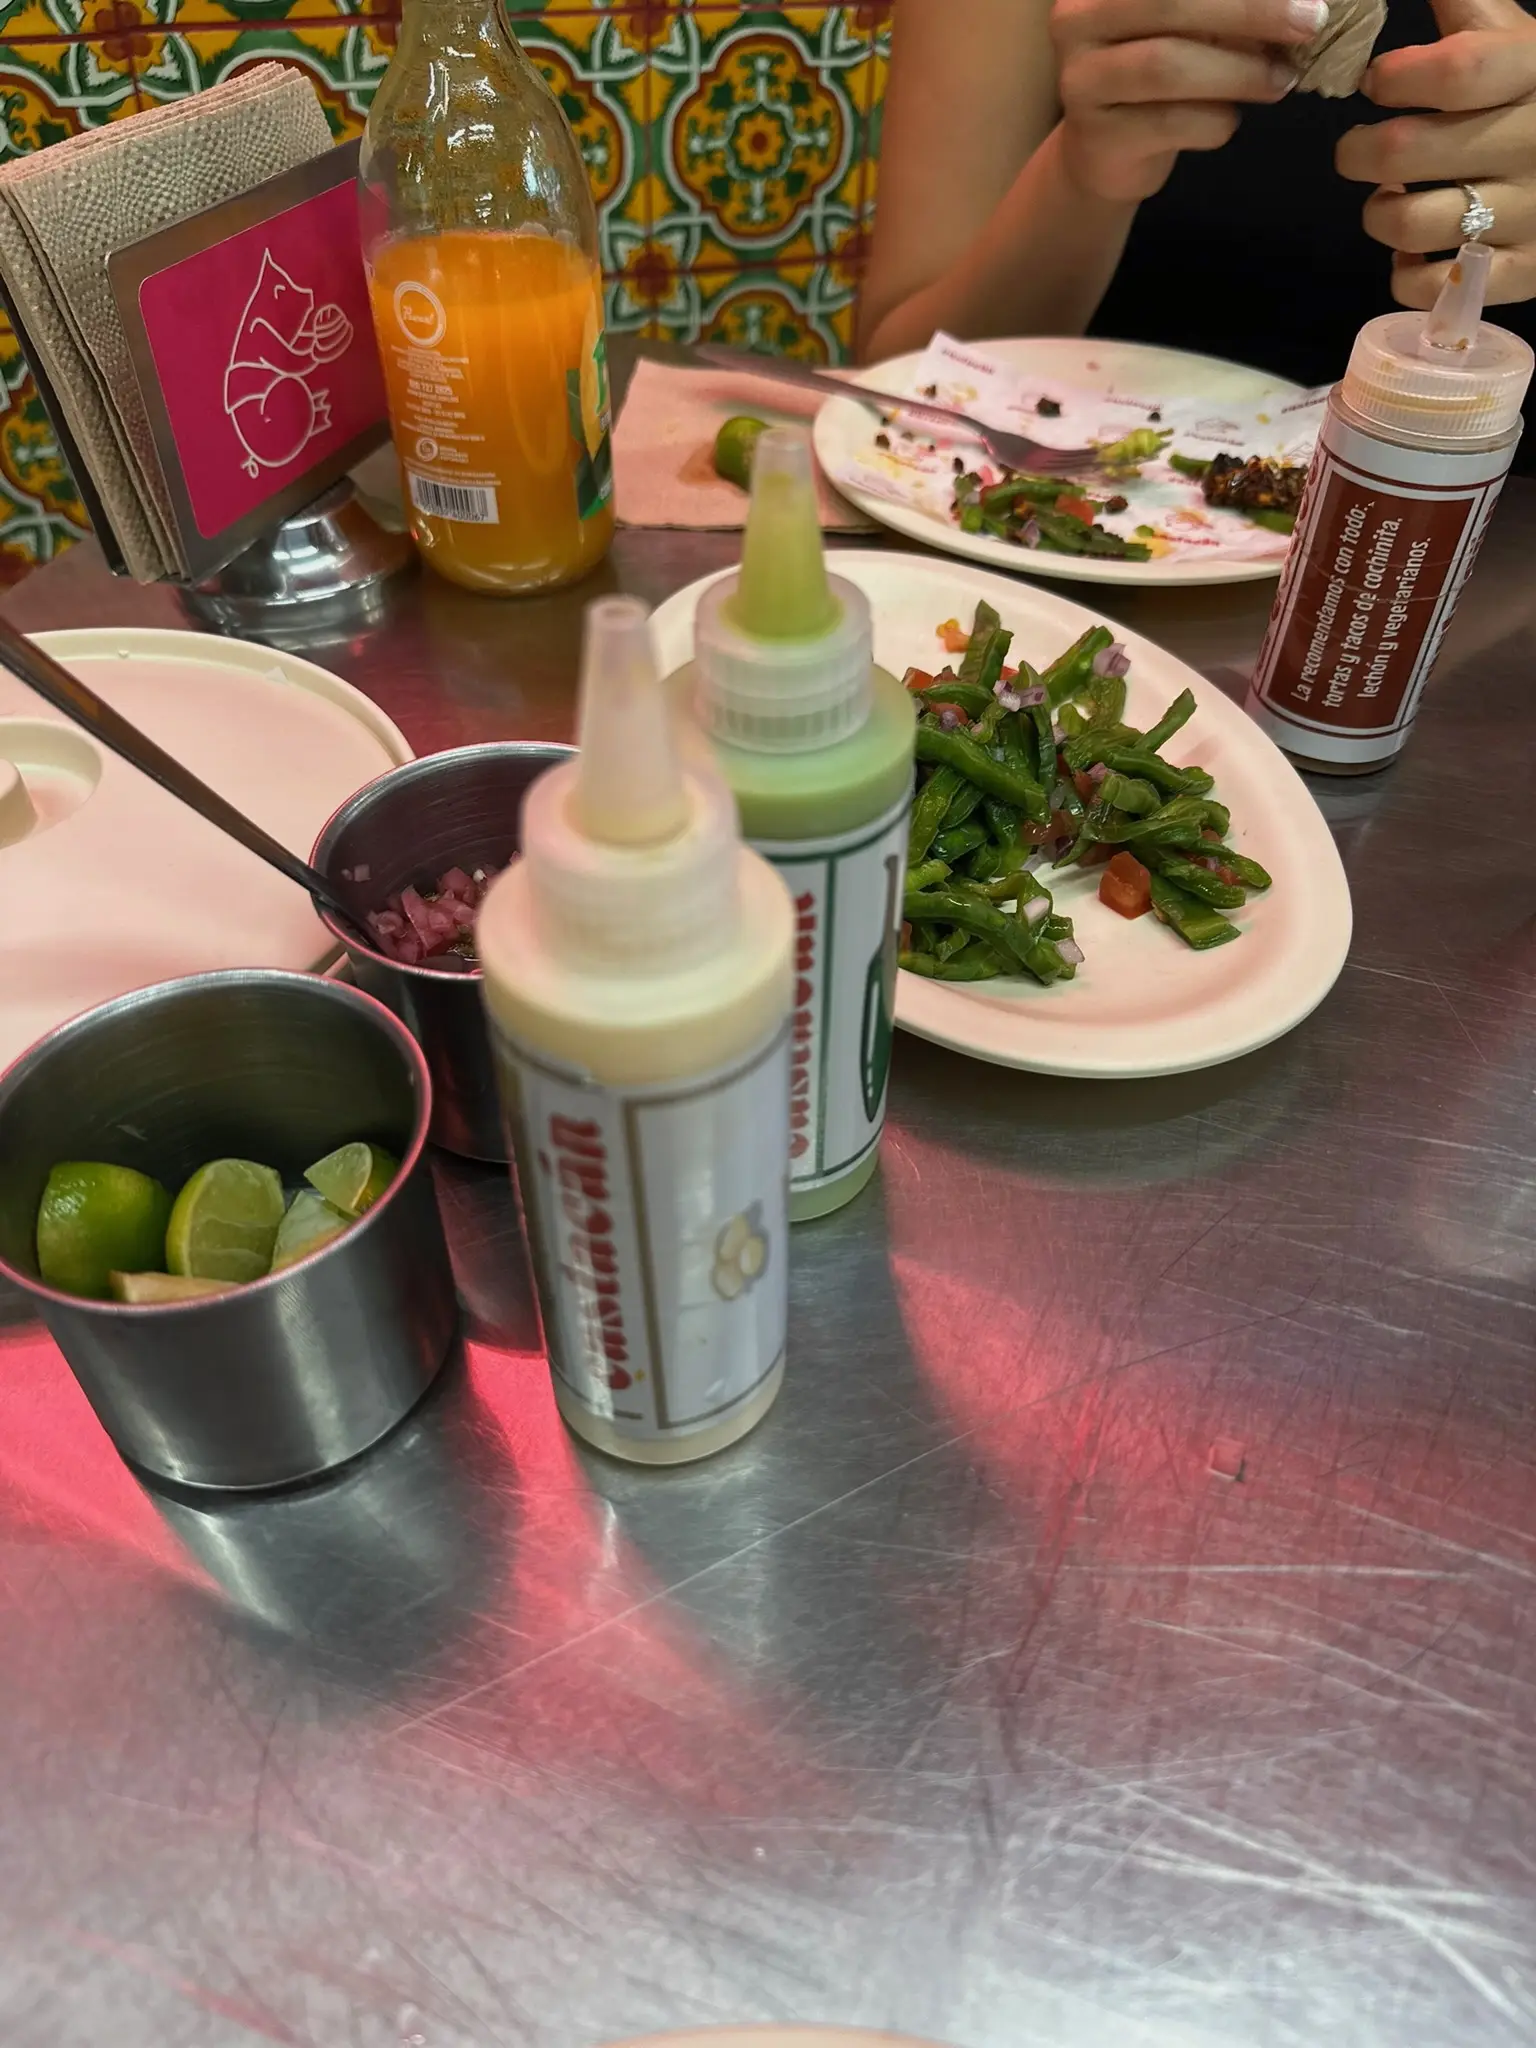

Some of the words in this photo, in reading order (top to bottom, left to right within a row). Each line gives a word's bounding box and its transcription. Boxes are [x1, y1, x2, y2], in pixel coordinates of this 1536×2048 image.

[1339, 503, 1369, 546] todo:
[1334, 546, 1356, 575] con
[1353, 591, 1378, 611] de
[1381, 537, 1432, 638] vegetarianos.
[1301, 575, 1346, 684] recomendamos
[1340, 612, 1375, 651] tacos
[1378, 641, 1400, 652] y
[1340, 653, 1361, 666] y
[1356, 654, 1388, 700] lechón
[1290, 684, 1312, 702] La
[1321, 665, 1353, 708] tortas
